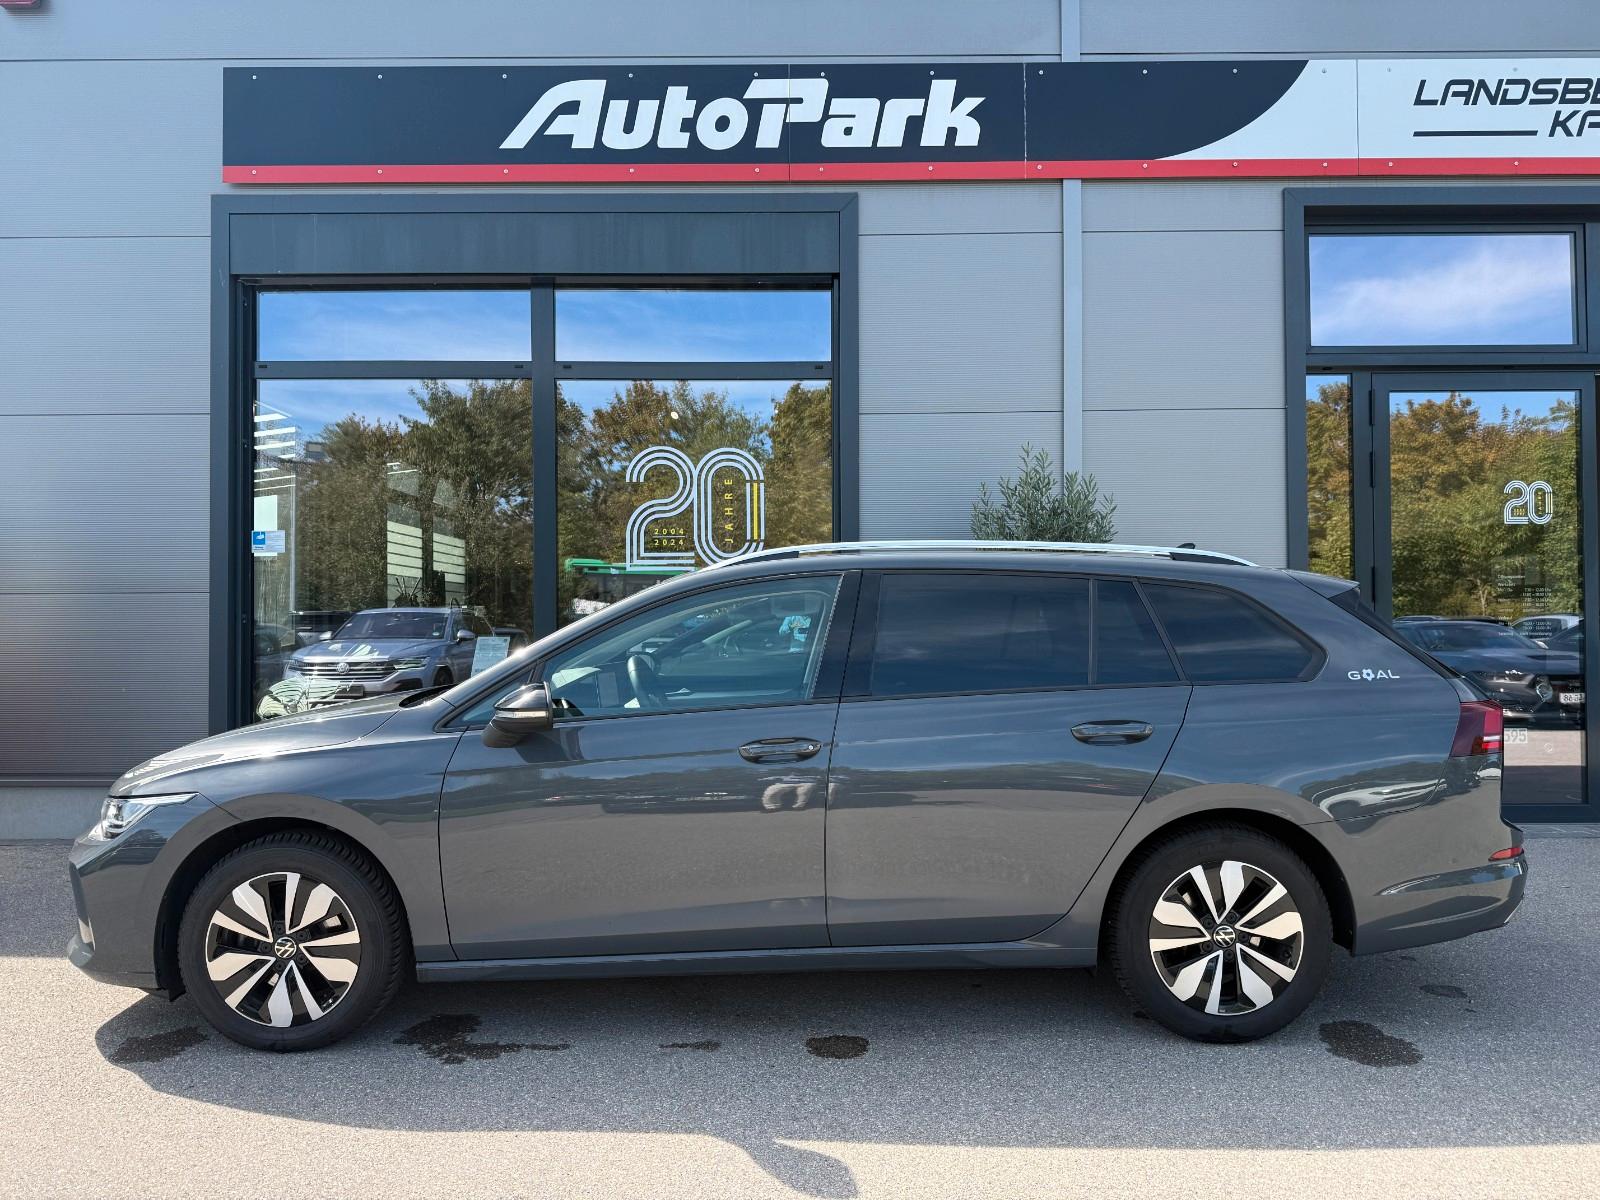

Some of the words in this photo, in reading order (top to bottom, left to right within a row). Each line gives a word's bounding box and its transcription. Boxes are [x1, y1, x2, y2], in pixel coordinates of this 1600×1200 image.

[499, 78, 986, 150] AutoPark
[625, 446, 765, 571] 20
[724, 479, 734, 543] JAHRE
[1503, 480, 1553, 524] 20
